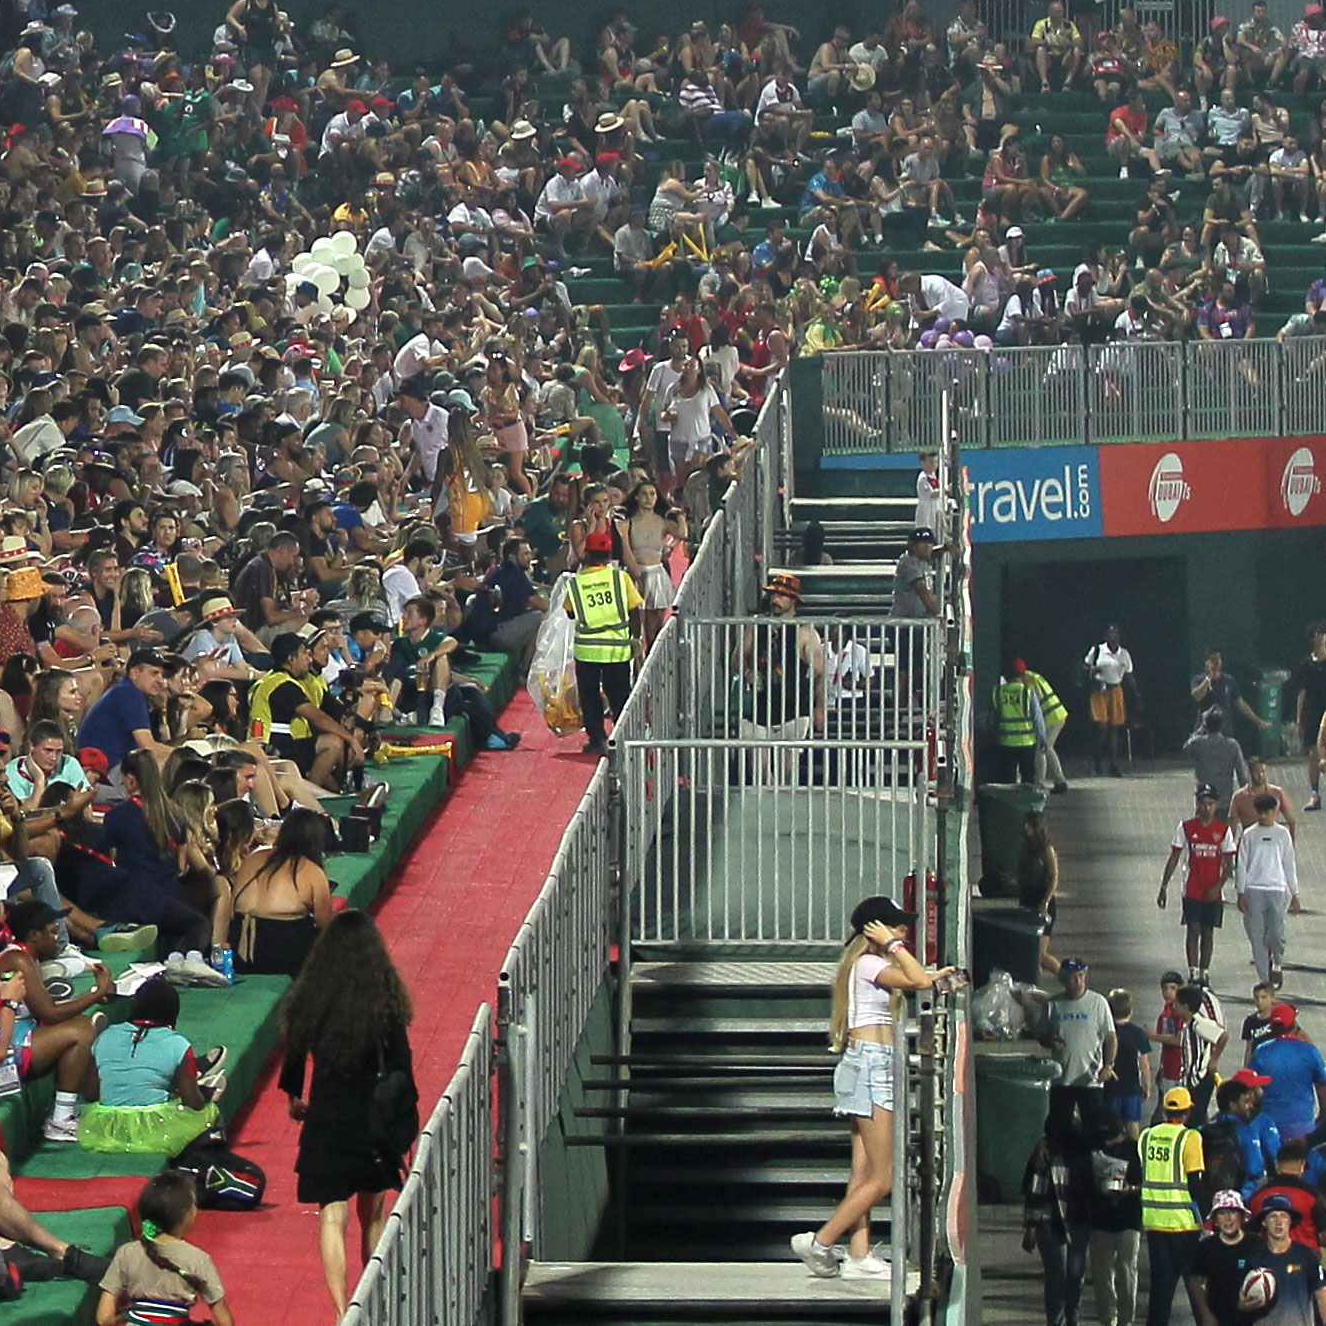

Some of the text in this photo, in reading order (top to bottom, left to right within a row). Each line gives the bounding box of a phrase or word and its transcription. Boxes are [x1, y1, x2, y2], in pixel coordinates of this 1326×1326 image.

[968, 465, 1073, 524] ravel
[587, 591, 613, 607] 338
[1148, 1146, 1170, 1162] 358
